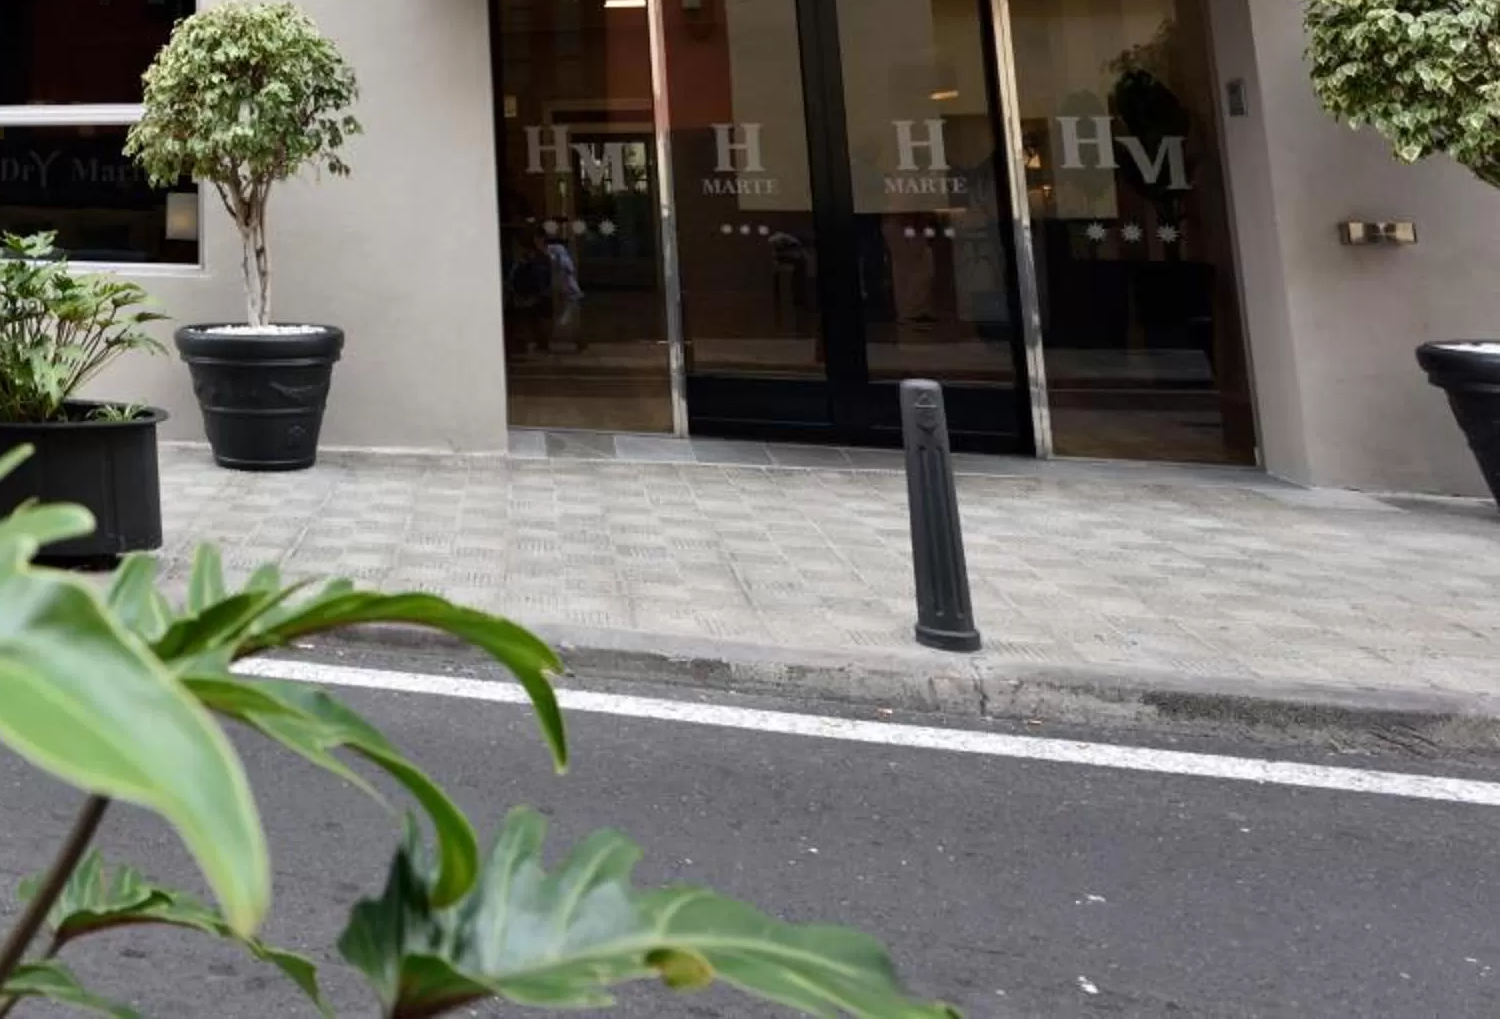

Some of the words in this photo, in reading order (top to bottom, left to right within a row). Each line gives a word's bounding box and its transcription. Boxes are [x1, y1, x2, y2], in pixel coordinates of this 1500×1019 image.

[711, 122, 766, 173] H
[891, 118, 951, 171] H
[701, 178, 779, 196] MARTE
[883, 176, 969, 195] MARTE
